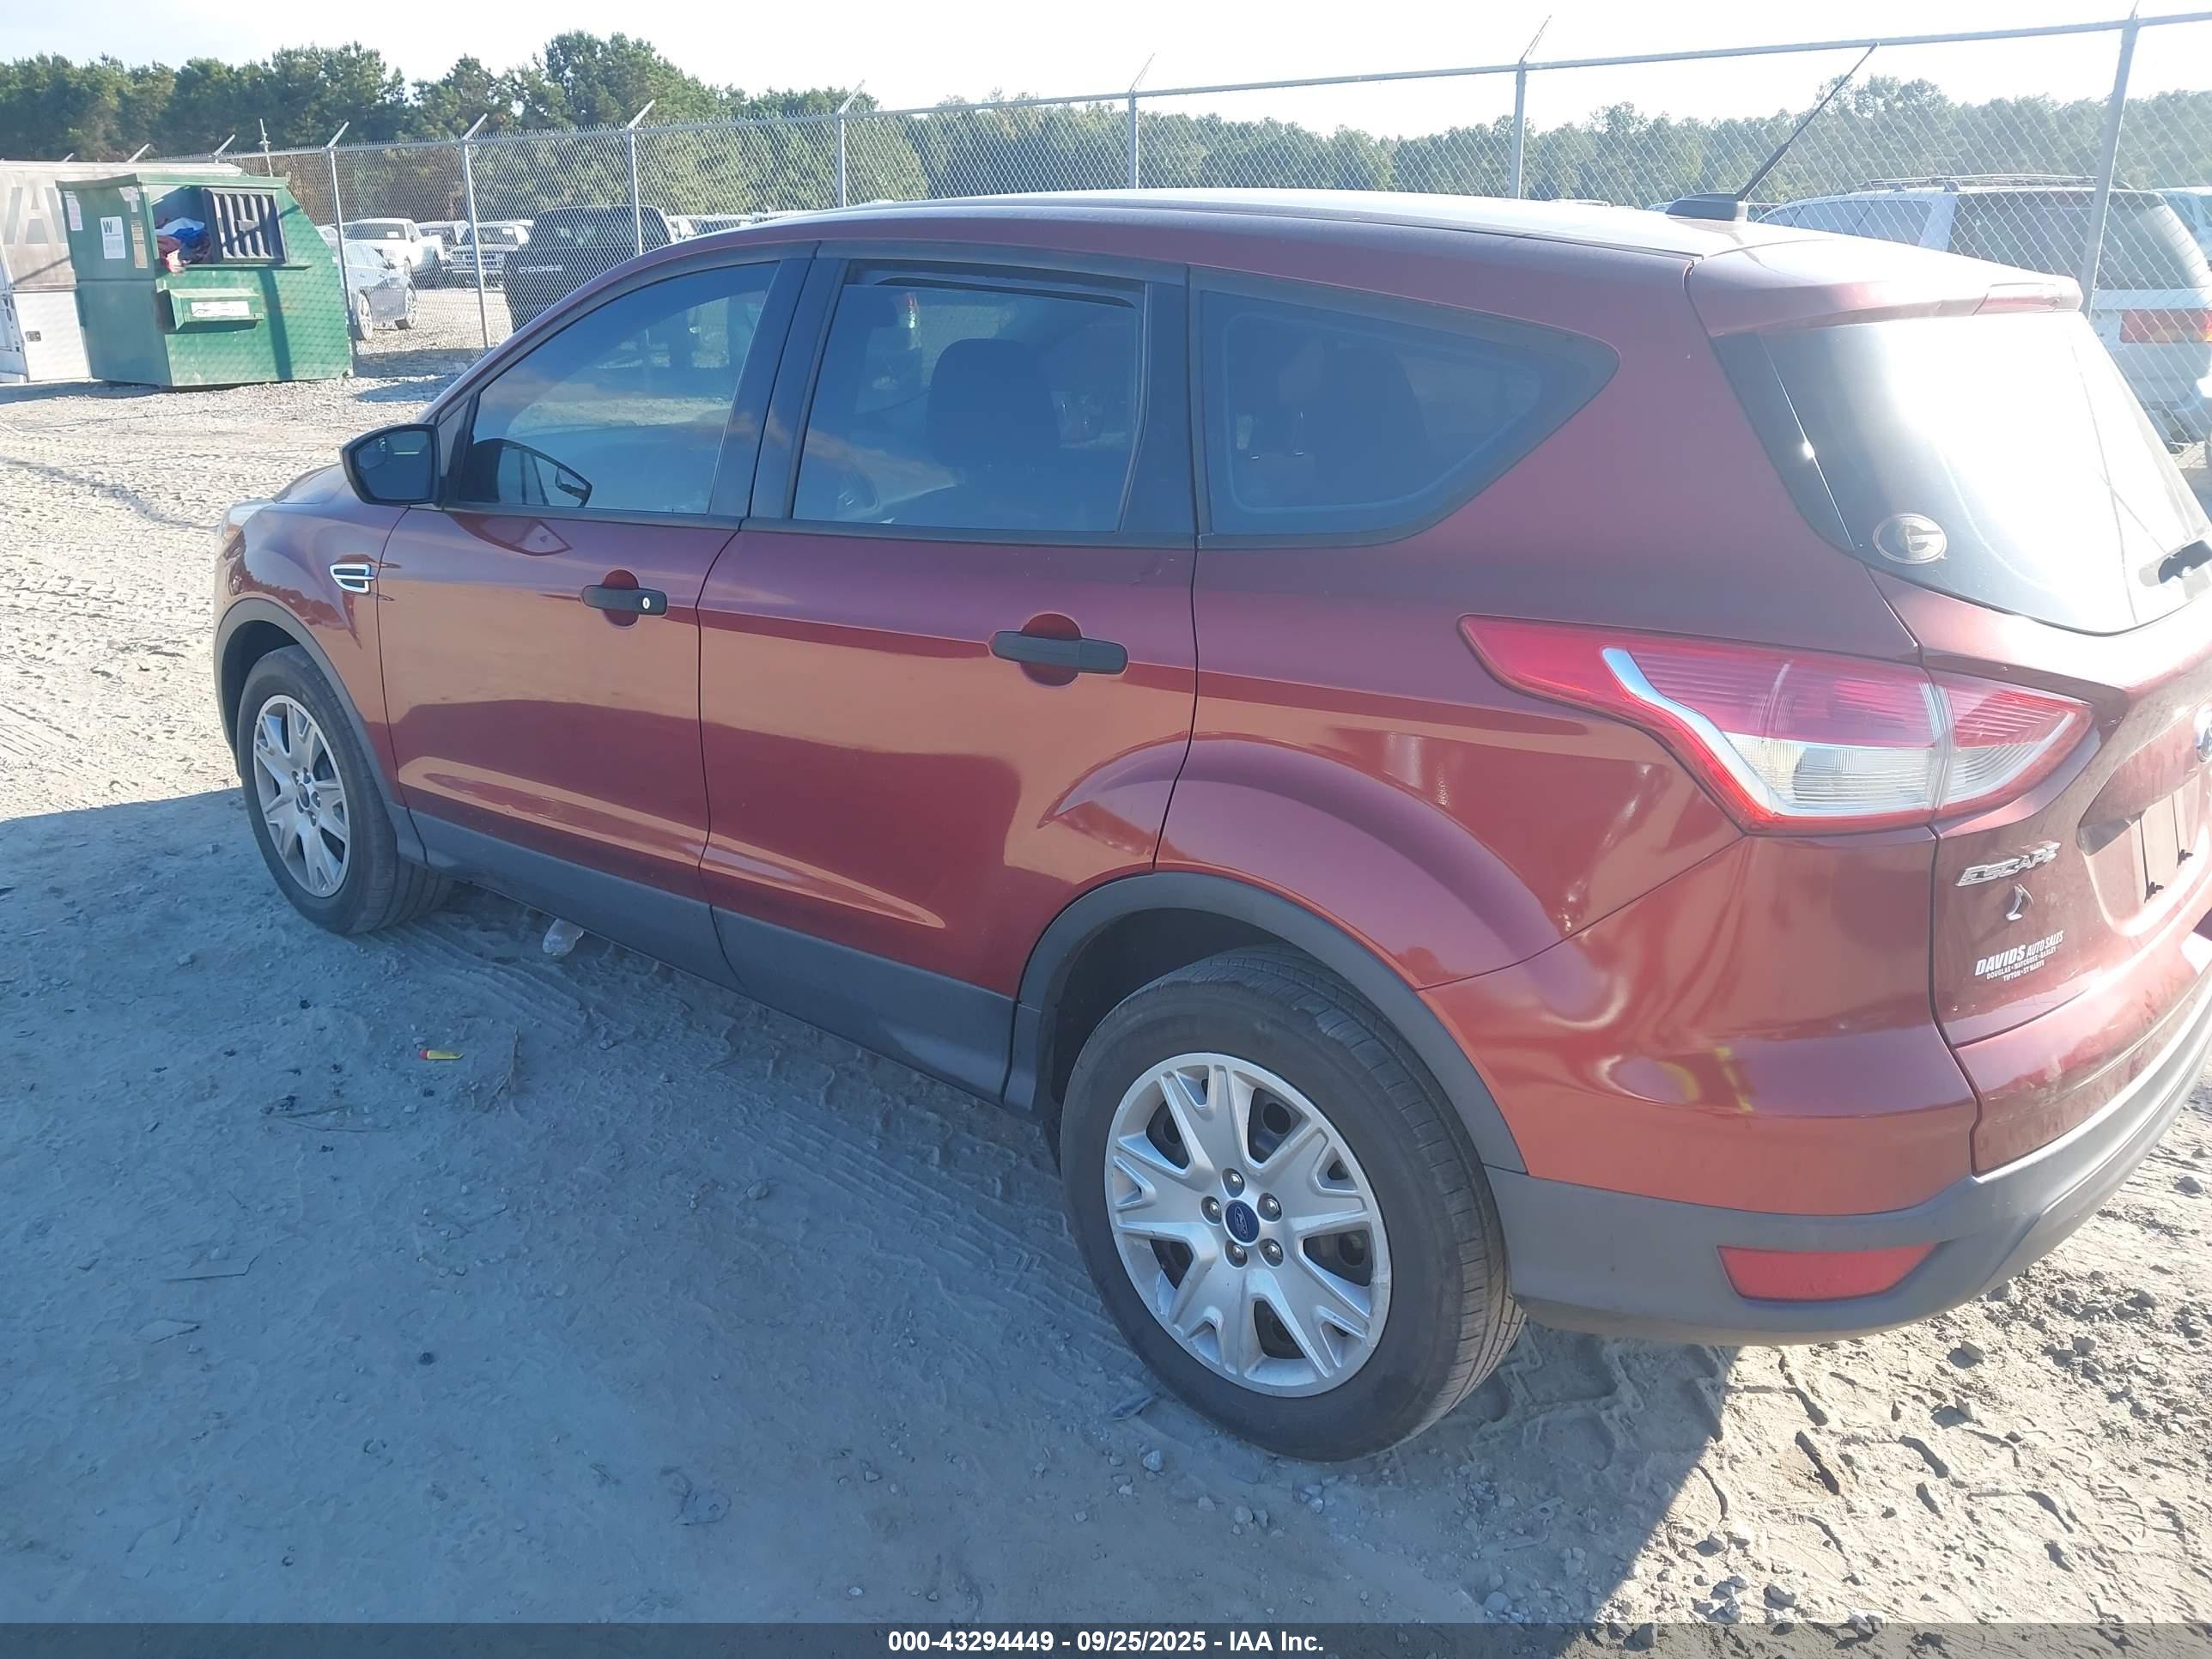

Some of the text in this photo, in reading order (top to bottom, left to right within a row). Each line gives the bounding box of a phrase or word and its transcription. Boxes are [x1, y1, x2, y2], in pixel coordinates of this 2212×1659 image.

[1955, 842, 2061, 886] ESCAPE
[1974, 930, 2064, 976] DAVIDS AUTO SALES
[1986, 965, 2012, 980] DOUGLAS
